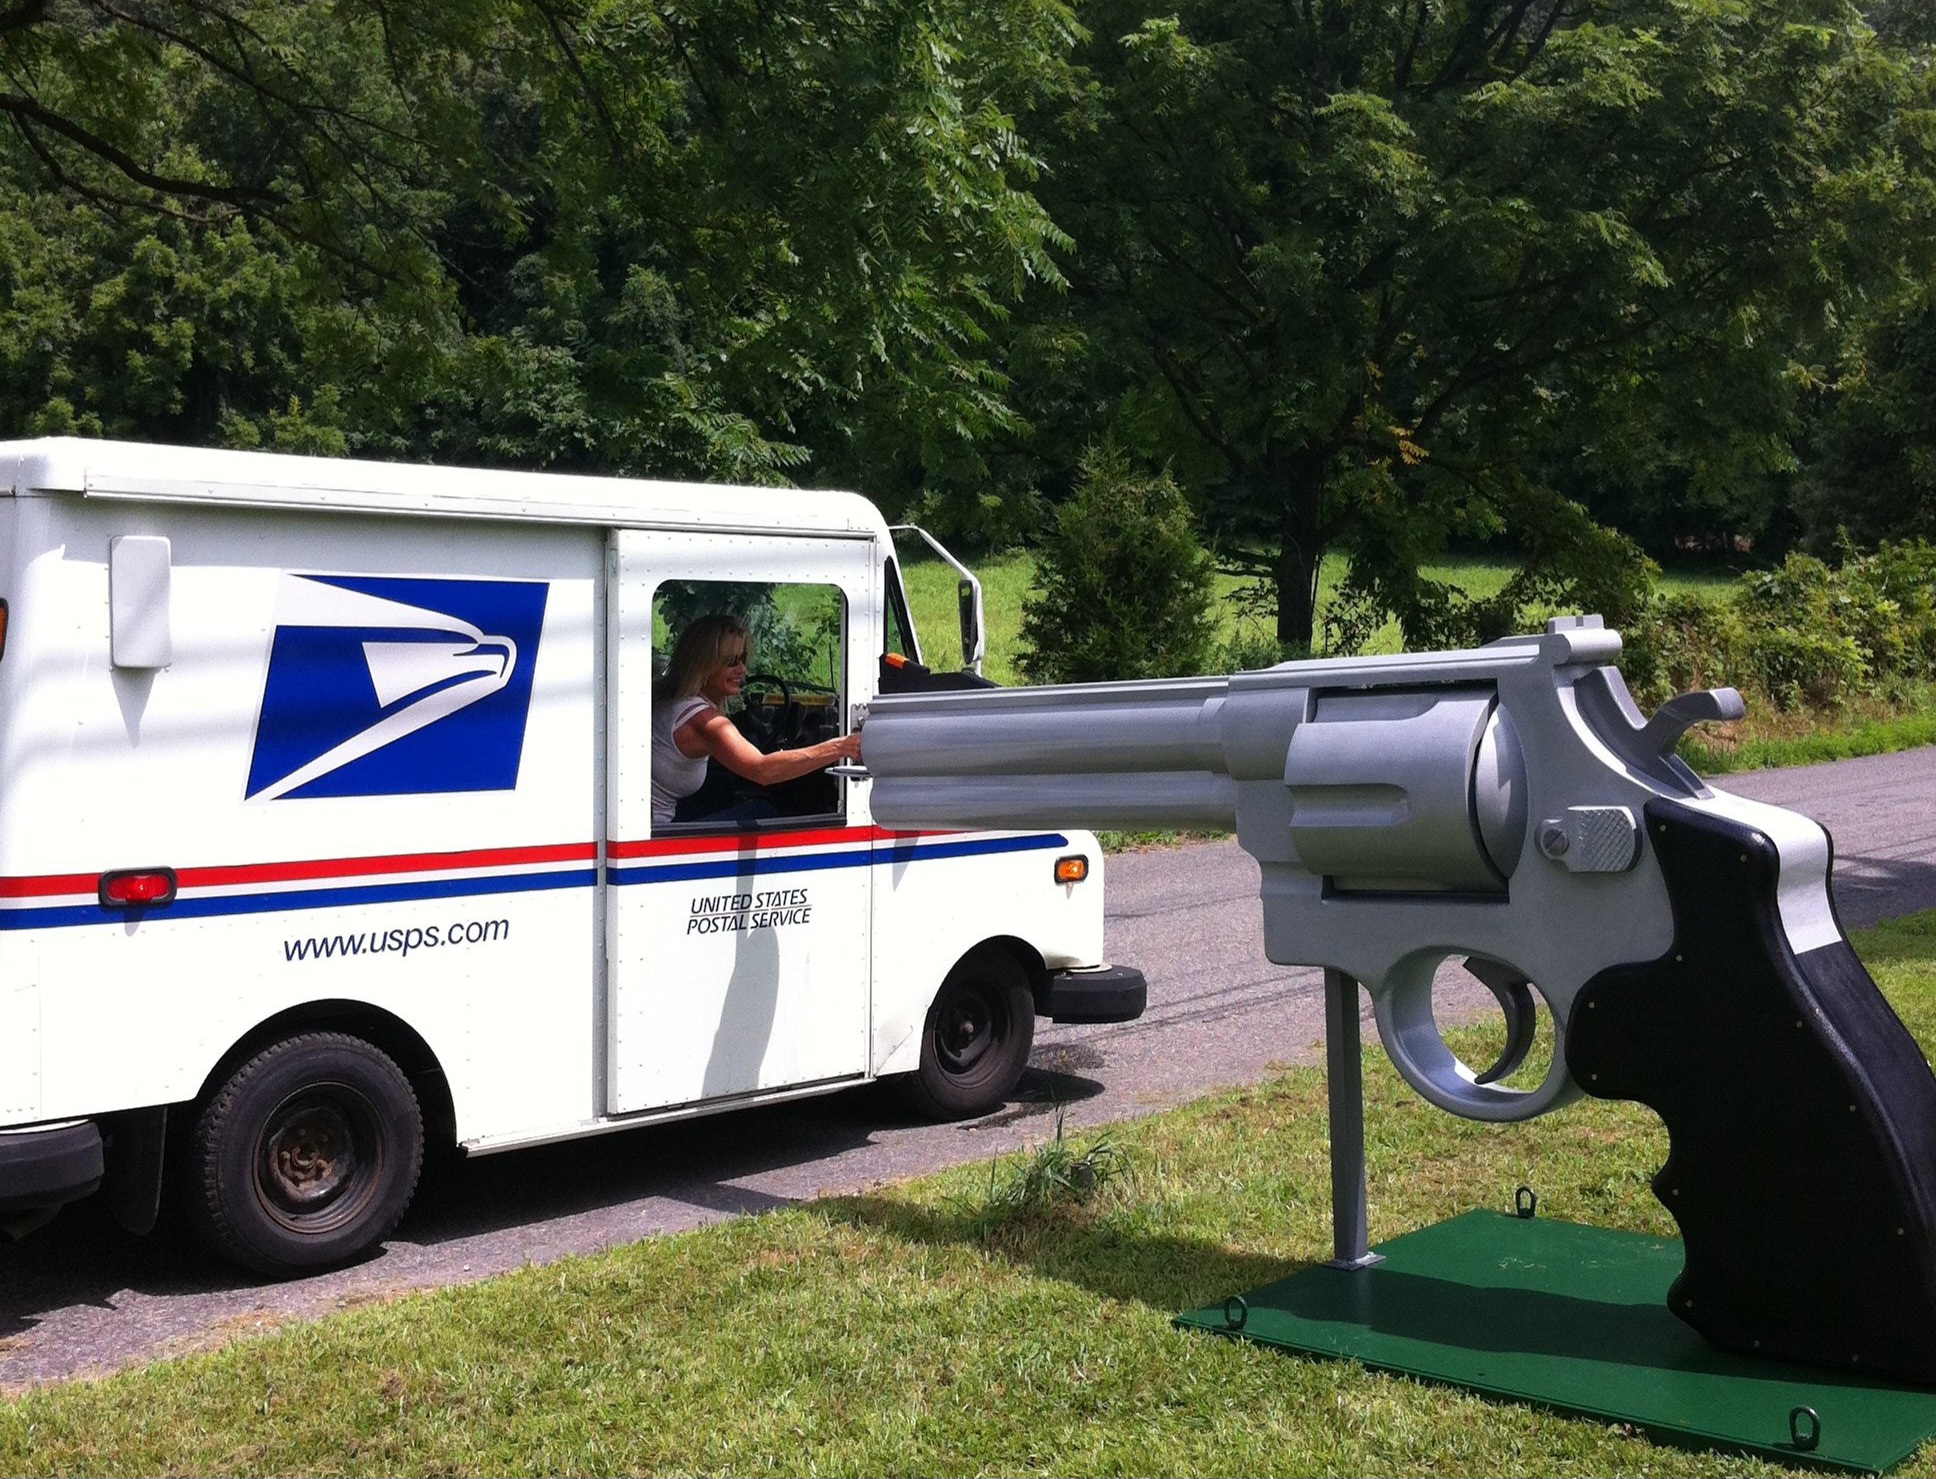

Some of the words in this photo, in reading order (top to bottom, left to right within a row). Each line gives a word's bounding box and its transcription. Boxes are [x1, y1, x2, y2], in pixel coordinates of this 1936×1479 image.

[691, 893, 753, 914] UNITED
[754, 888, 808, 909] STATES
[687, 914, 747, 935] POSTAL
[750, 908, 812, 929] SERVICE
[284, 919, 509, 961] www.usps.com
